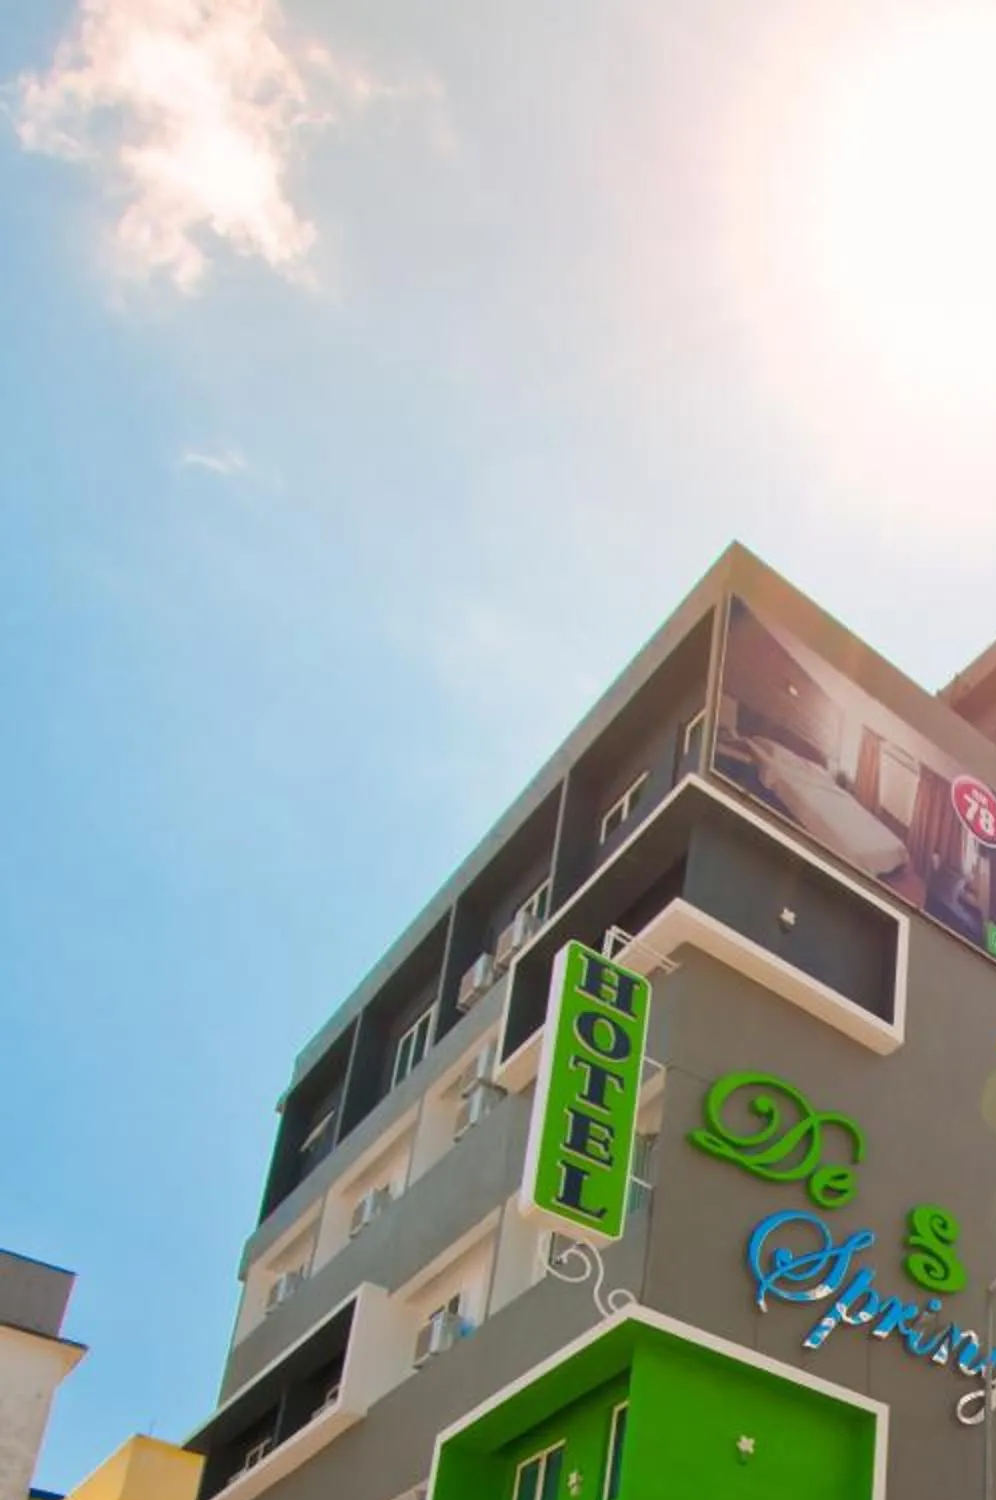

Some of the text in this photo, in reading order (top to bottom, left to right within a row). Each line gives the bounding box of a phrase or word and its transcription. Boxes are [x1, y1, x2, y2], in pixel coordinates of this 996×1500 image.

[963, 793, 996, 837] 78
[556, 952, 642, 1221] HOTEL
[686, 1068, 868, 1210] De
